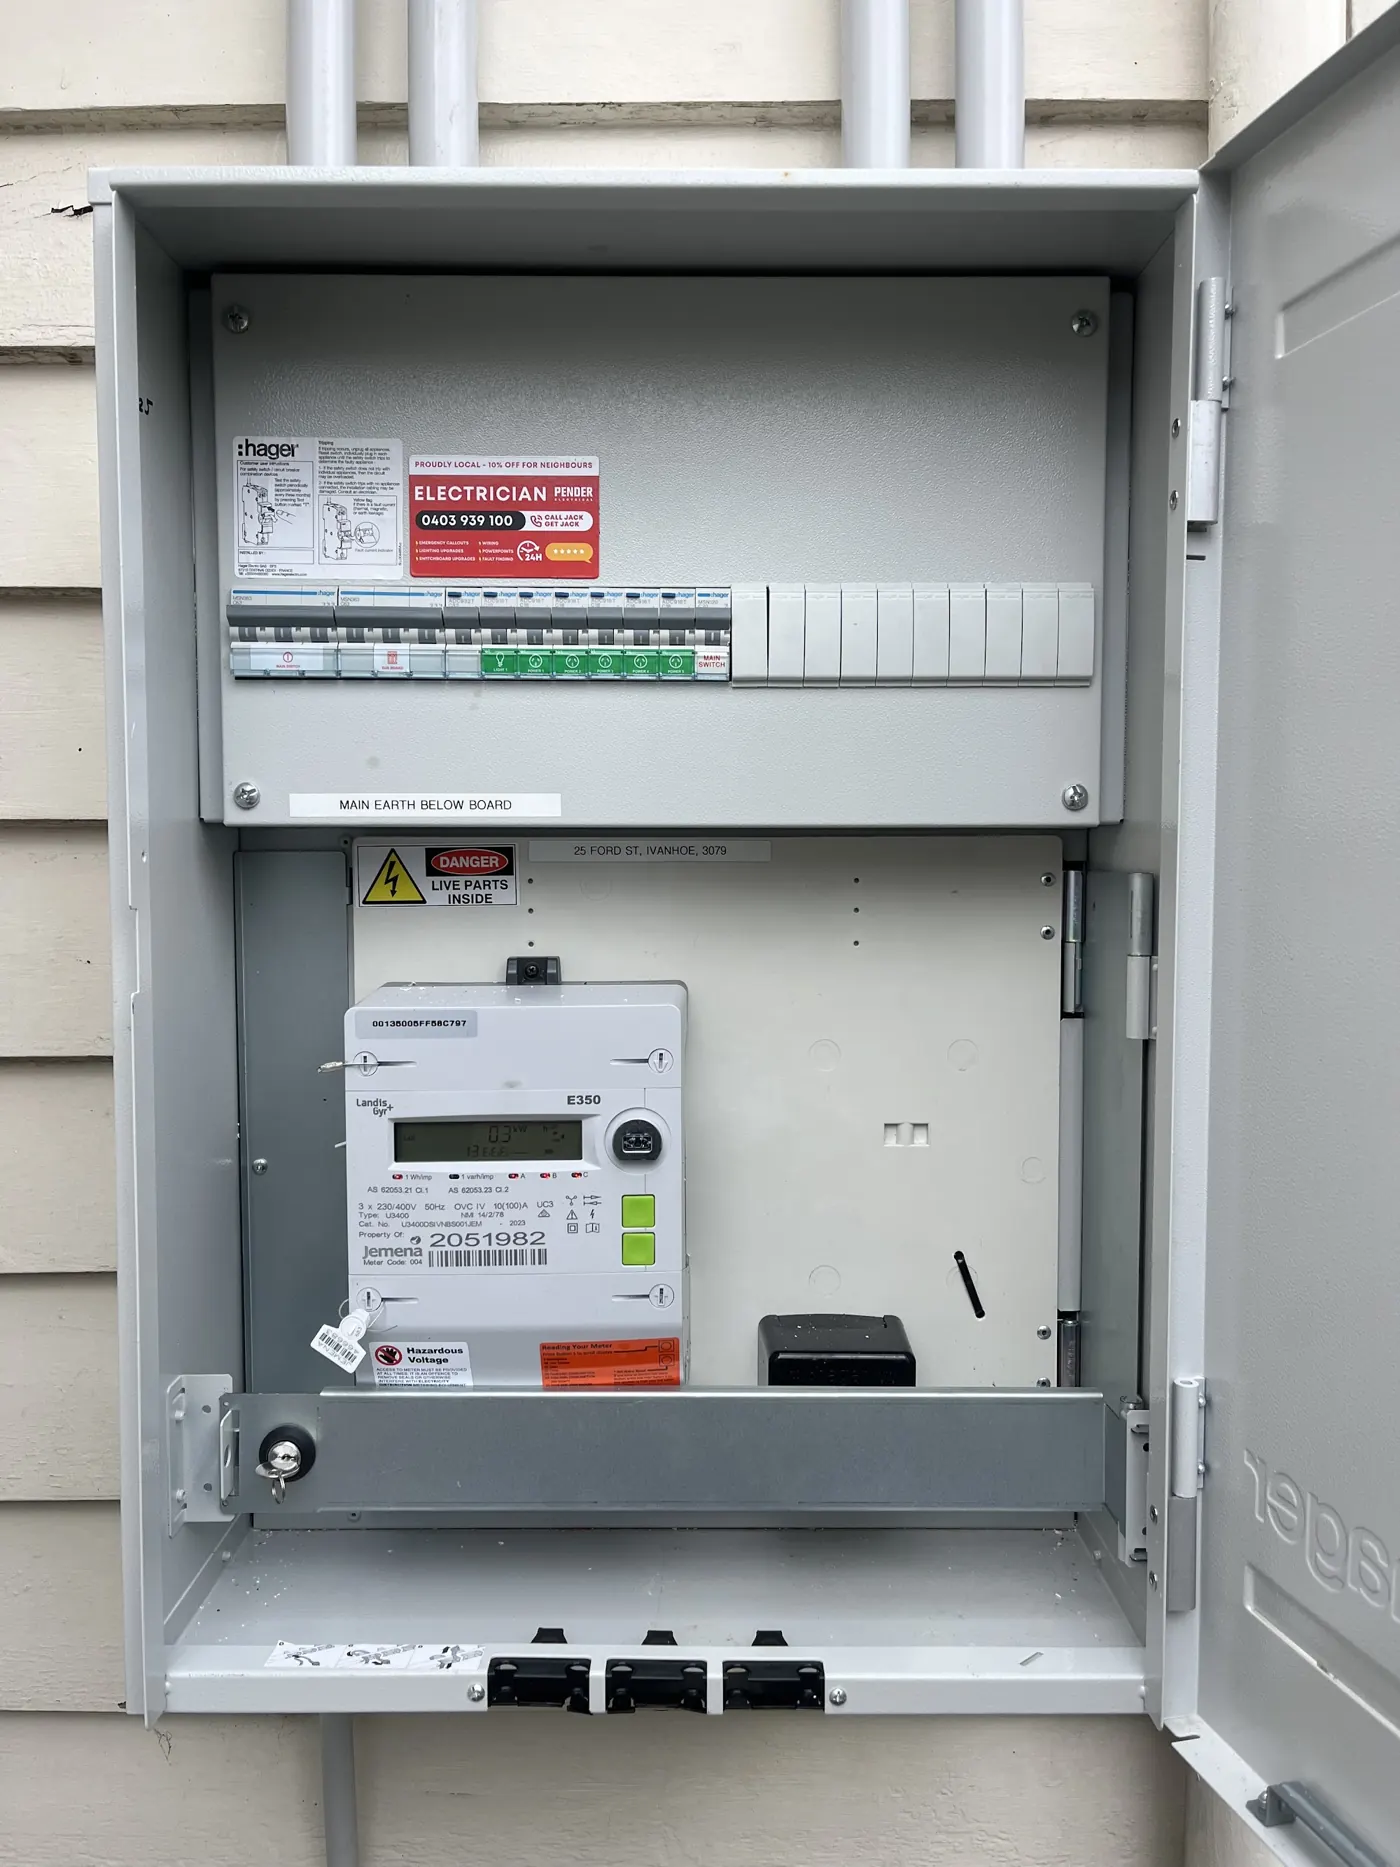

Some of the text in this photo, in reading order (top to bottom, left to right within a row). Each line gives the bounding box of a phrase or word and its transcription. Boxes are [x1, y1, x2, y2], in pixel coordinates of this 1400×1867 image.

[415, 461, 452, 469] PROUDLY
[454, 461, 480, 469] LOCAL
[488, 461, 503, 469] 10%
[504, 461, 520, 469] OFF
[522, 461, 538, 469] FOR
[540, 461, 593, 469] NEIGHBOURS
[414, 486, 547, 501] ELECTRICIAN
[554, 486, 593, 497] PENDER
[421, 514, 513, 527] 0403 939 100
[339, 800, 512, 810] MAIN EARTH BELOW BOARD
[574, 846, 727, 857] 25 FORD ST, IVANHOE, 3079
[439, 856, 500, 868] DANGER
[431, 880, 508, 891] LIVE PARTS
[448, 894, 493, 905] INSIDE
[567, 1095, 601, 1105] E350
[467, 1173, 494, 1181] varh/imp
[493, 1202, 528, 1210] 10(100)A
[430, 1232, 546, 1247] 2051982
[362, 1245, 423, 1259] Jemena
